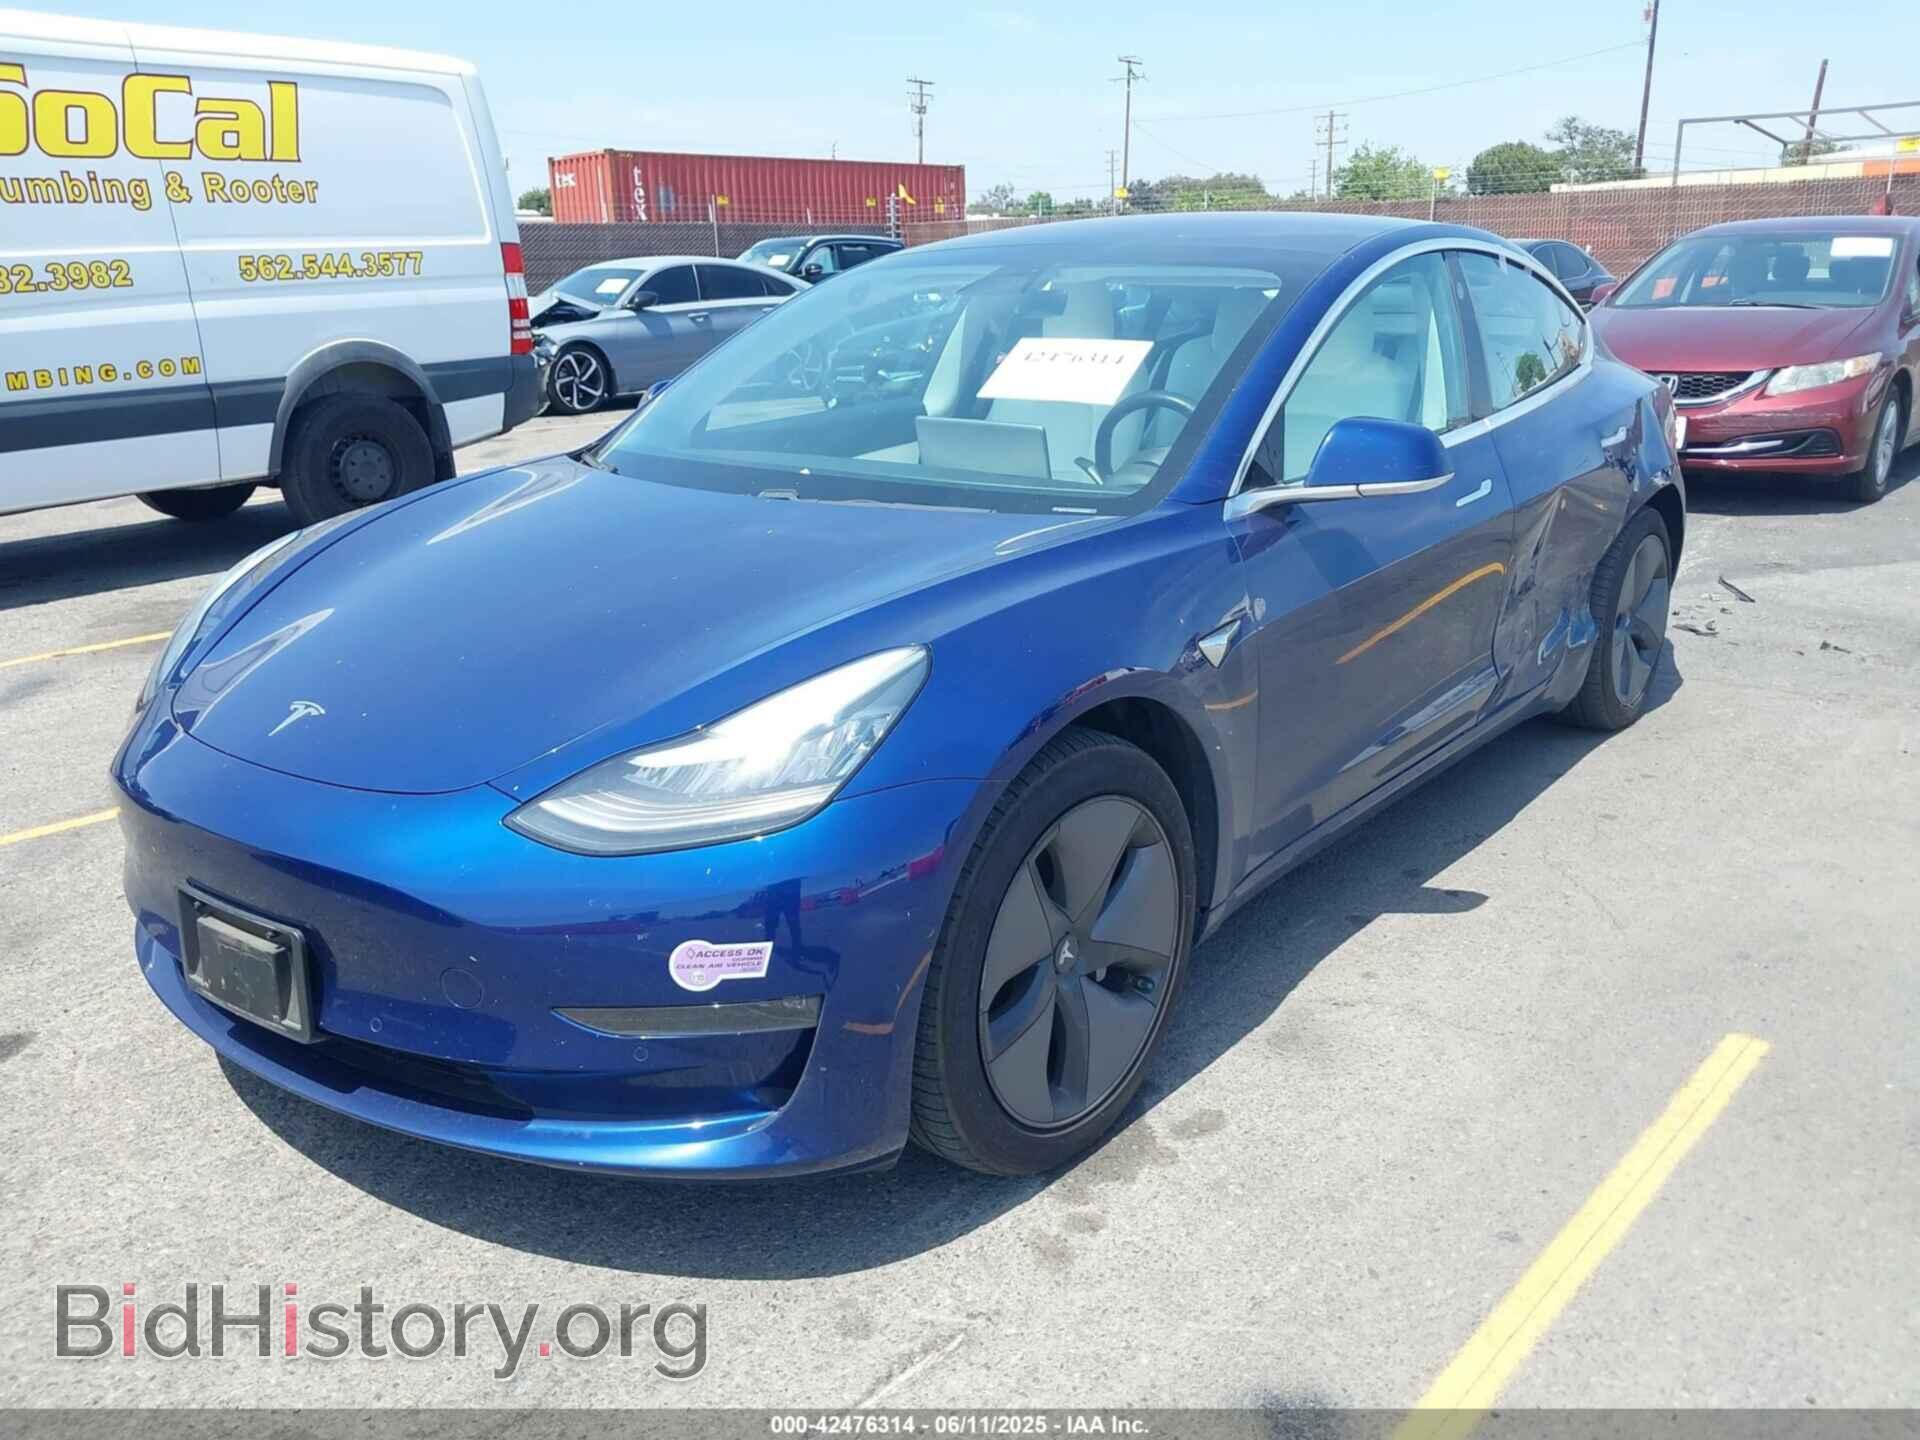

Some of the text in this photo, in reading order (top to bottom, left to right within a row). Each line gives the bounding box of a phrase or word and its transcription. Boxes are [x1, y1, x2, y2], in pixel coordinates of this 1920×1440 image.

[165, 172, 192, 203] &
[202, 172, 318, 204] Rooter
[239, 251, 423, 281] 562.544.3577
[5, 356, 202, 392] MBING.COM
[696, 948, 763, 958] ACCESS OK
